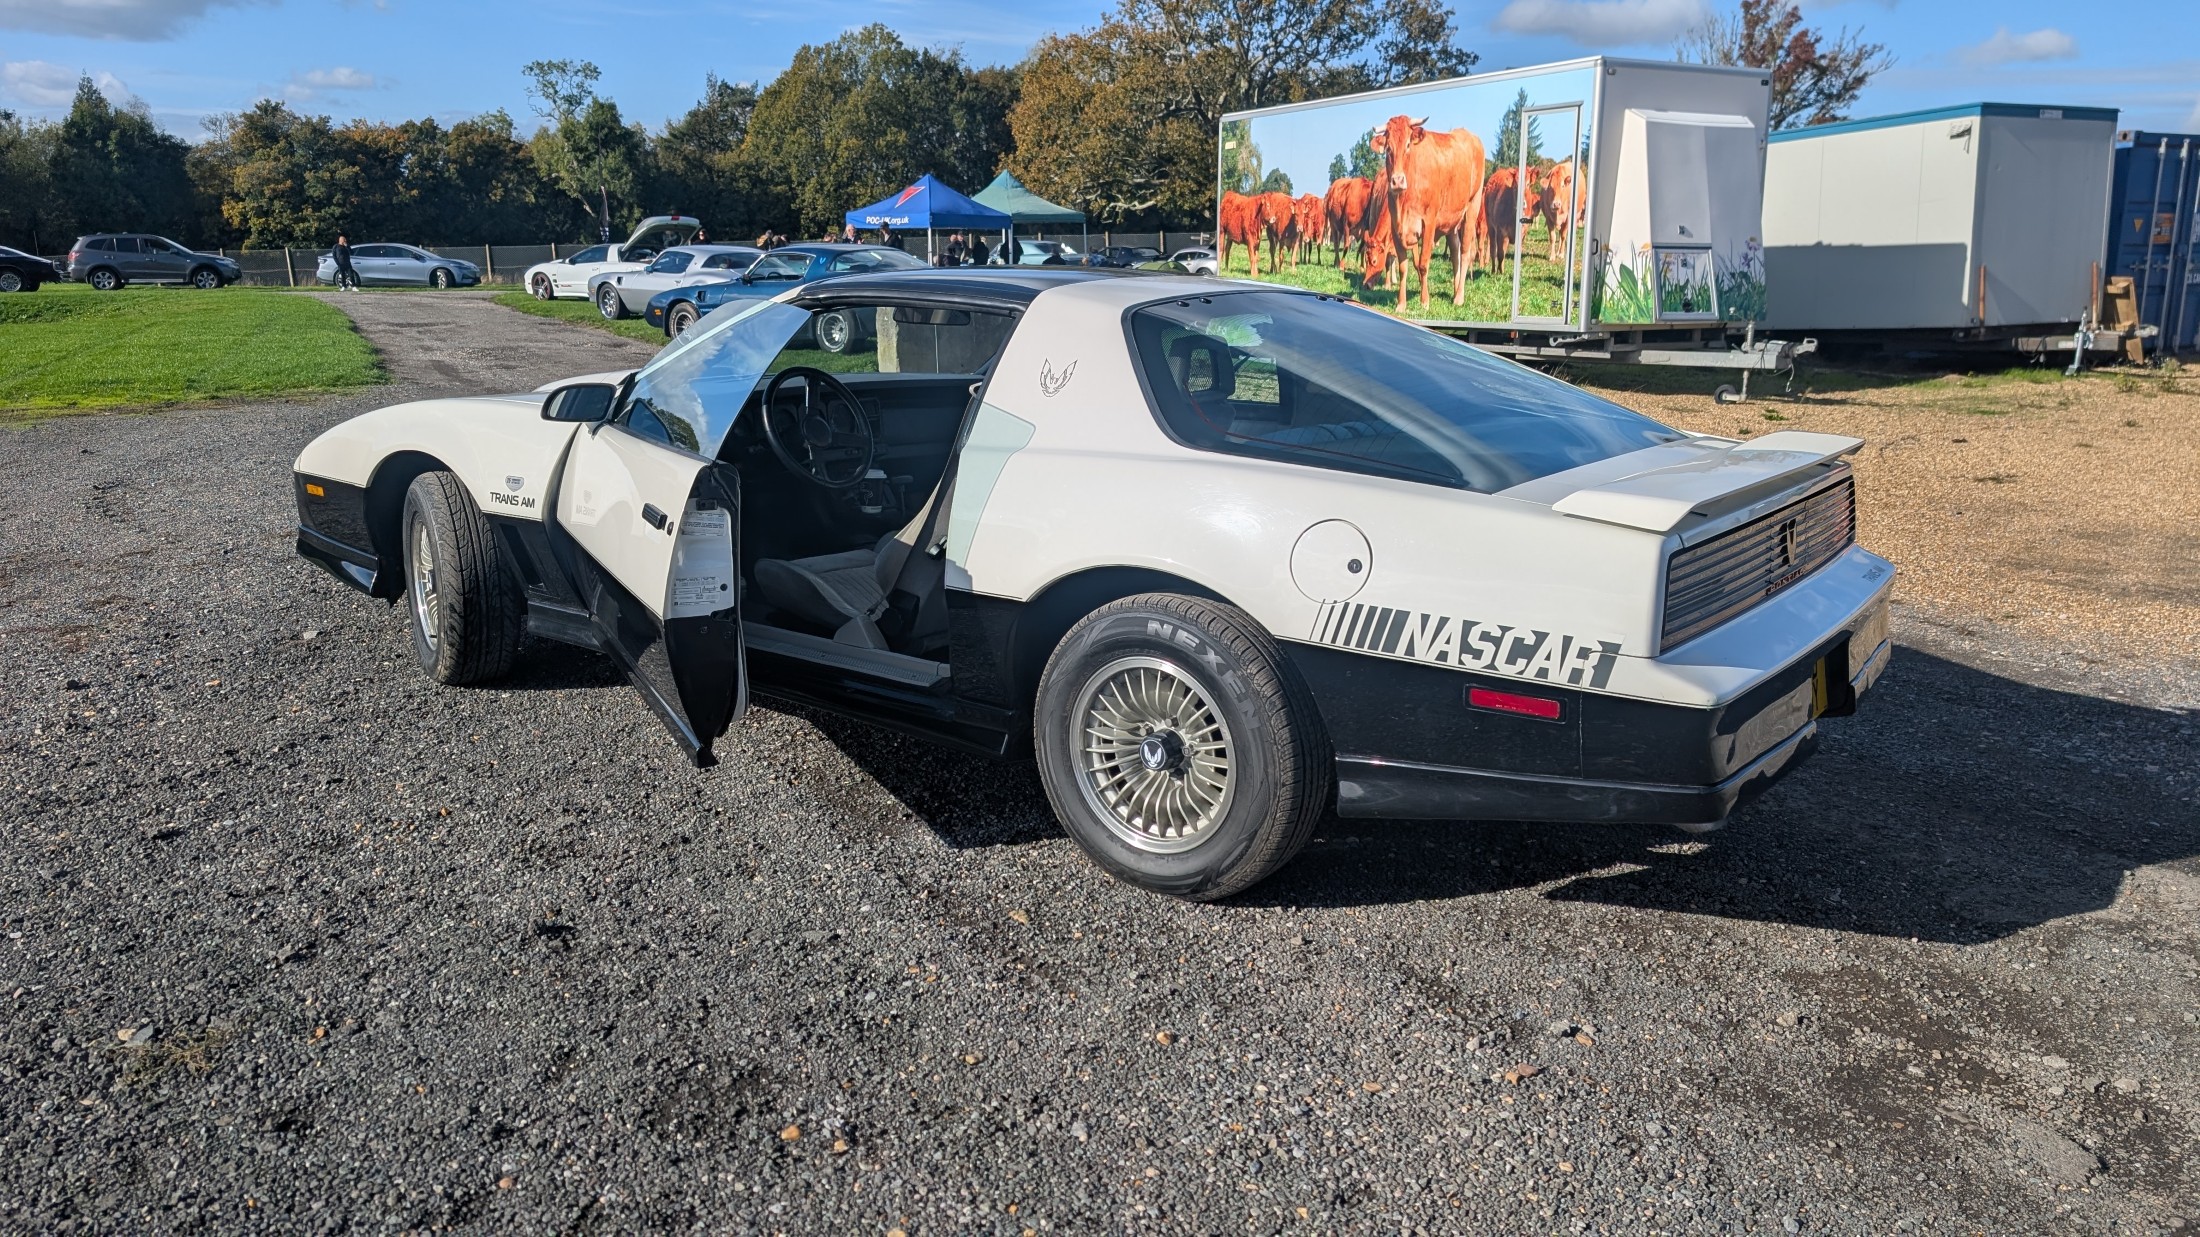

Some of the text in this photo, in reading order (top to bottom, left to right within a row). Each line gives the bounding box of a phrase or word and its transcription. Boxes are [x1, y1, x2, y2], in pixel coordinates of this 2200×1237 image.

[489, 491, 535, 508] TRANS AM
[1146, 619, 1261, 730] NEXEN
[1398, 611, 1605, 689] NASCAR
